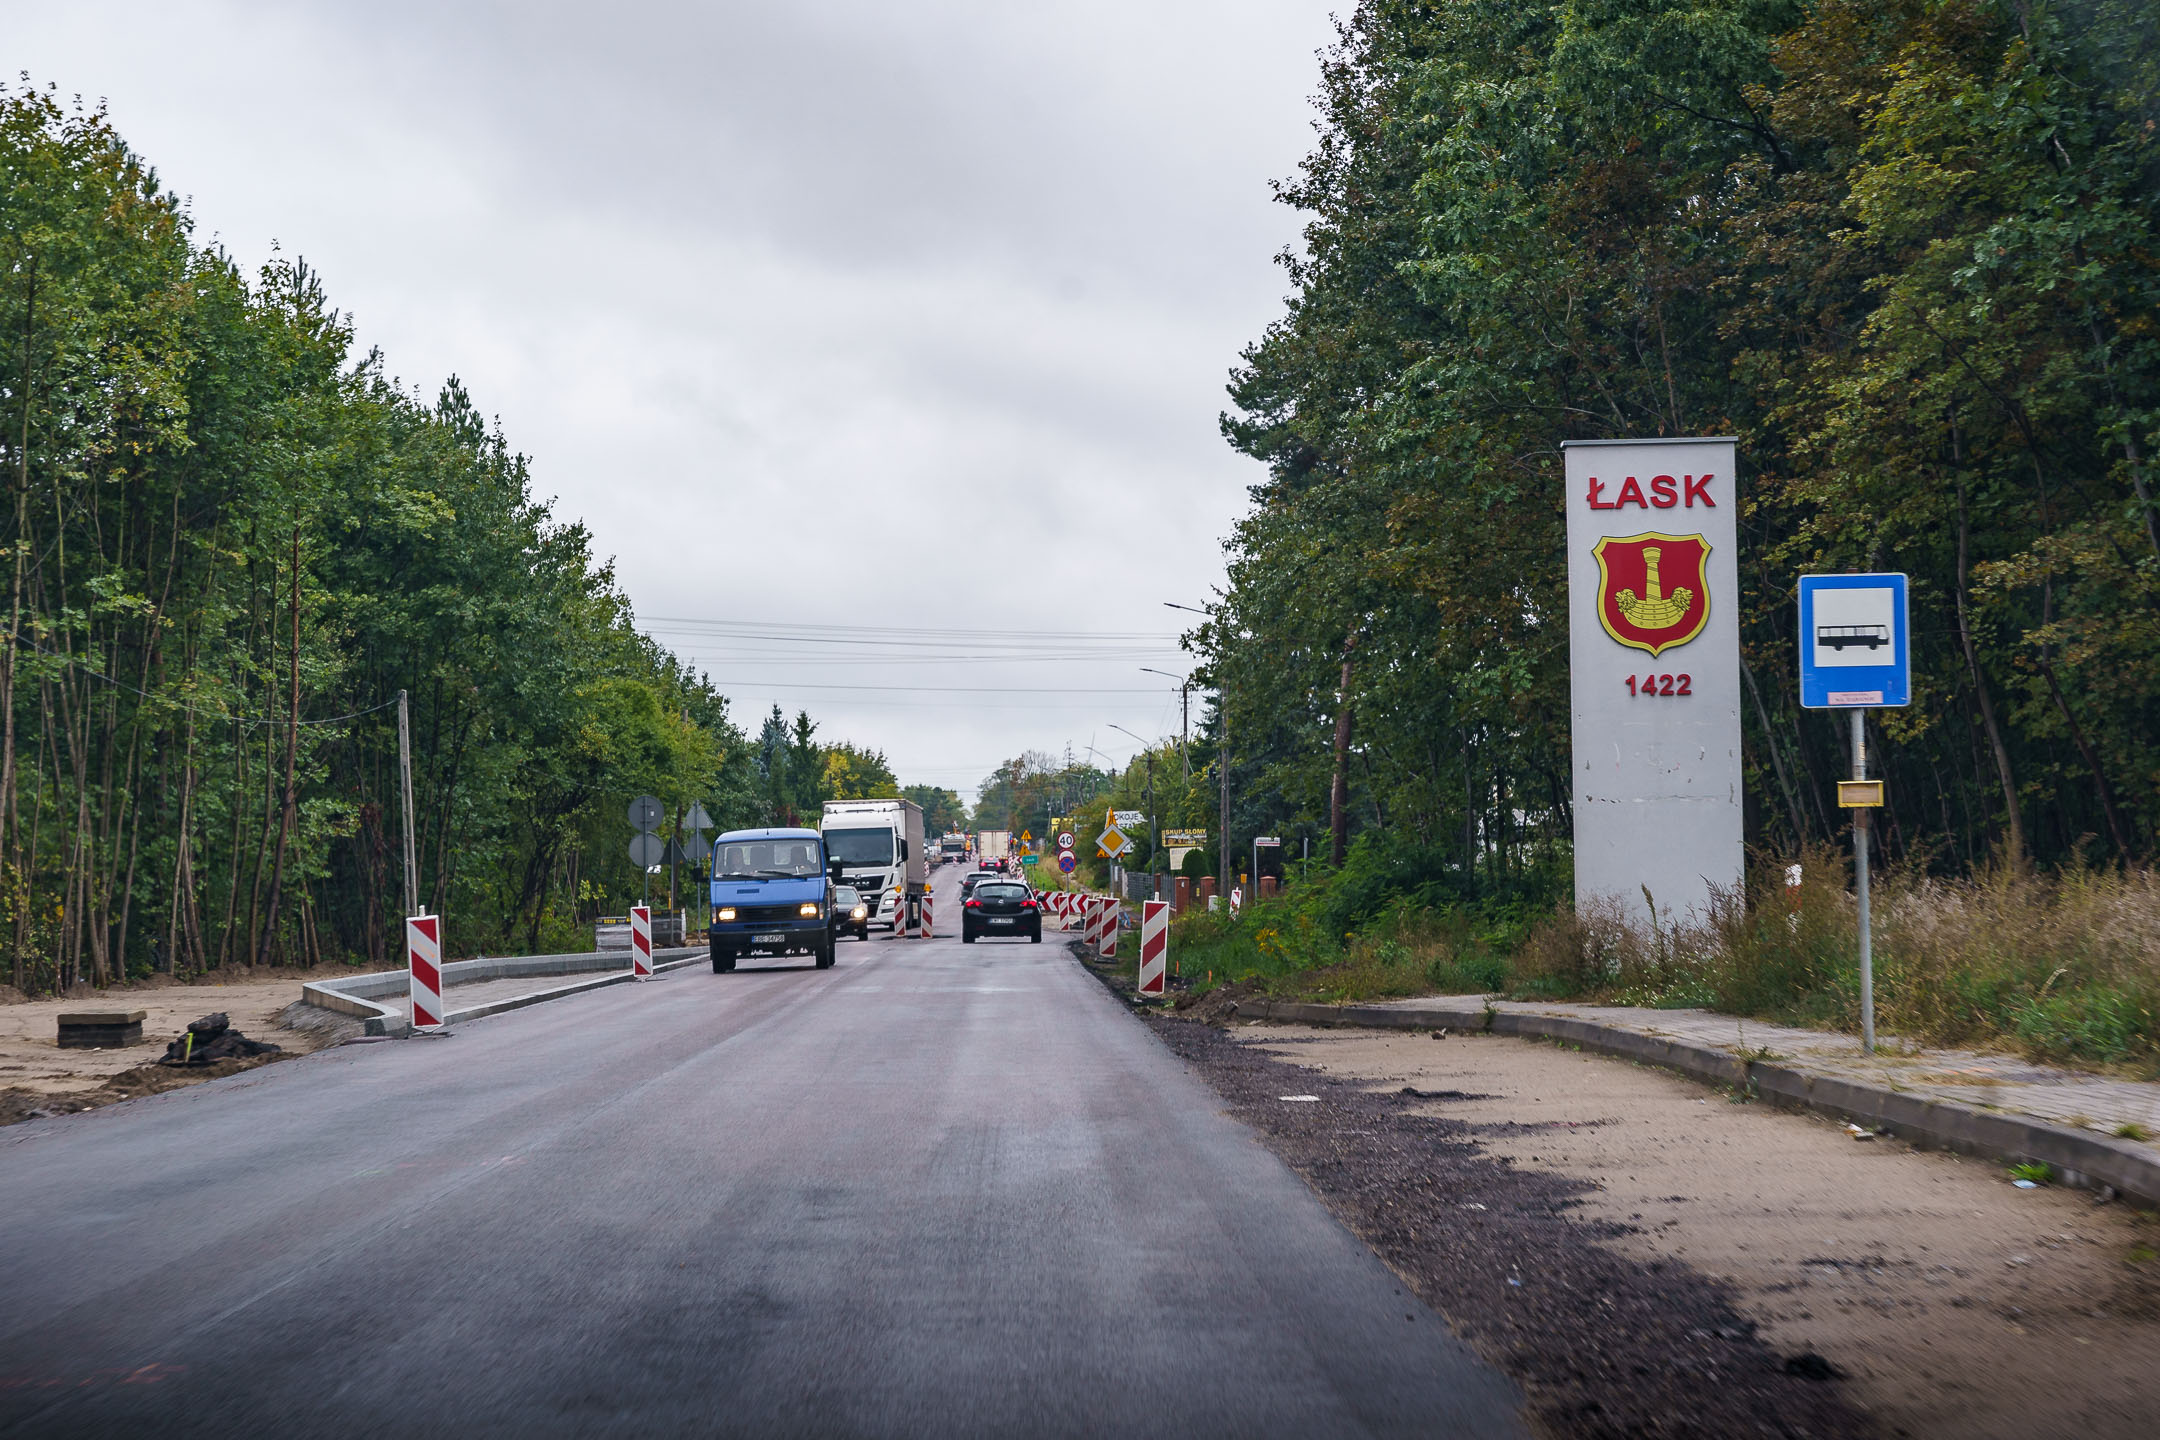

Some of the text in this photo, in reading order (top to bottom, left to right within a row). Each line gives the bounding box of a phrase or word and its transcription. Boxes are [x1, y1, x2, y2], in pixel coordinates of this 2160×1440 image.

[1586, 474, 1716, 510] ŁASK
[1625, 674, 1692, 696] 1422
[1114, 813, 1139, 821] OKOJE
[1060, 836, 1072, 845] 40
